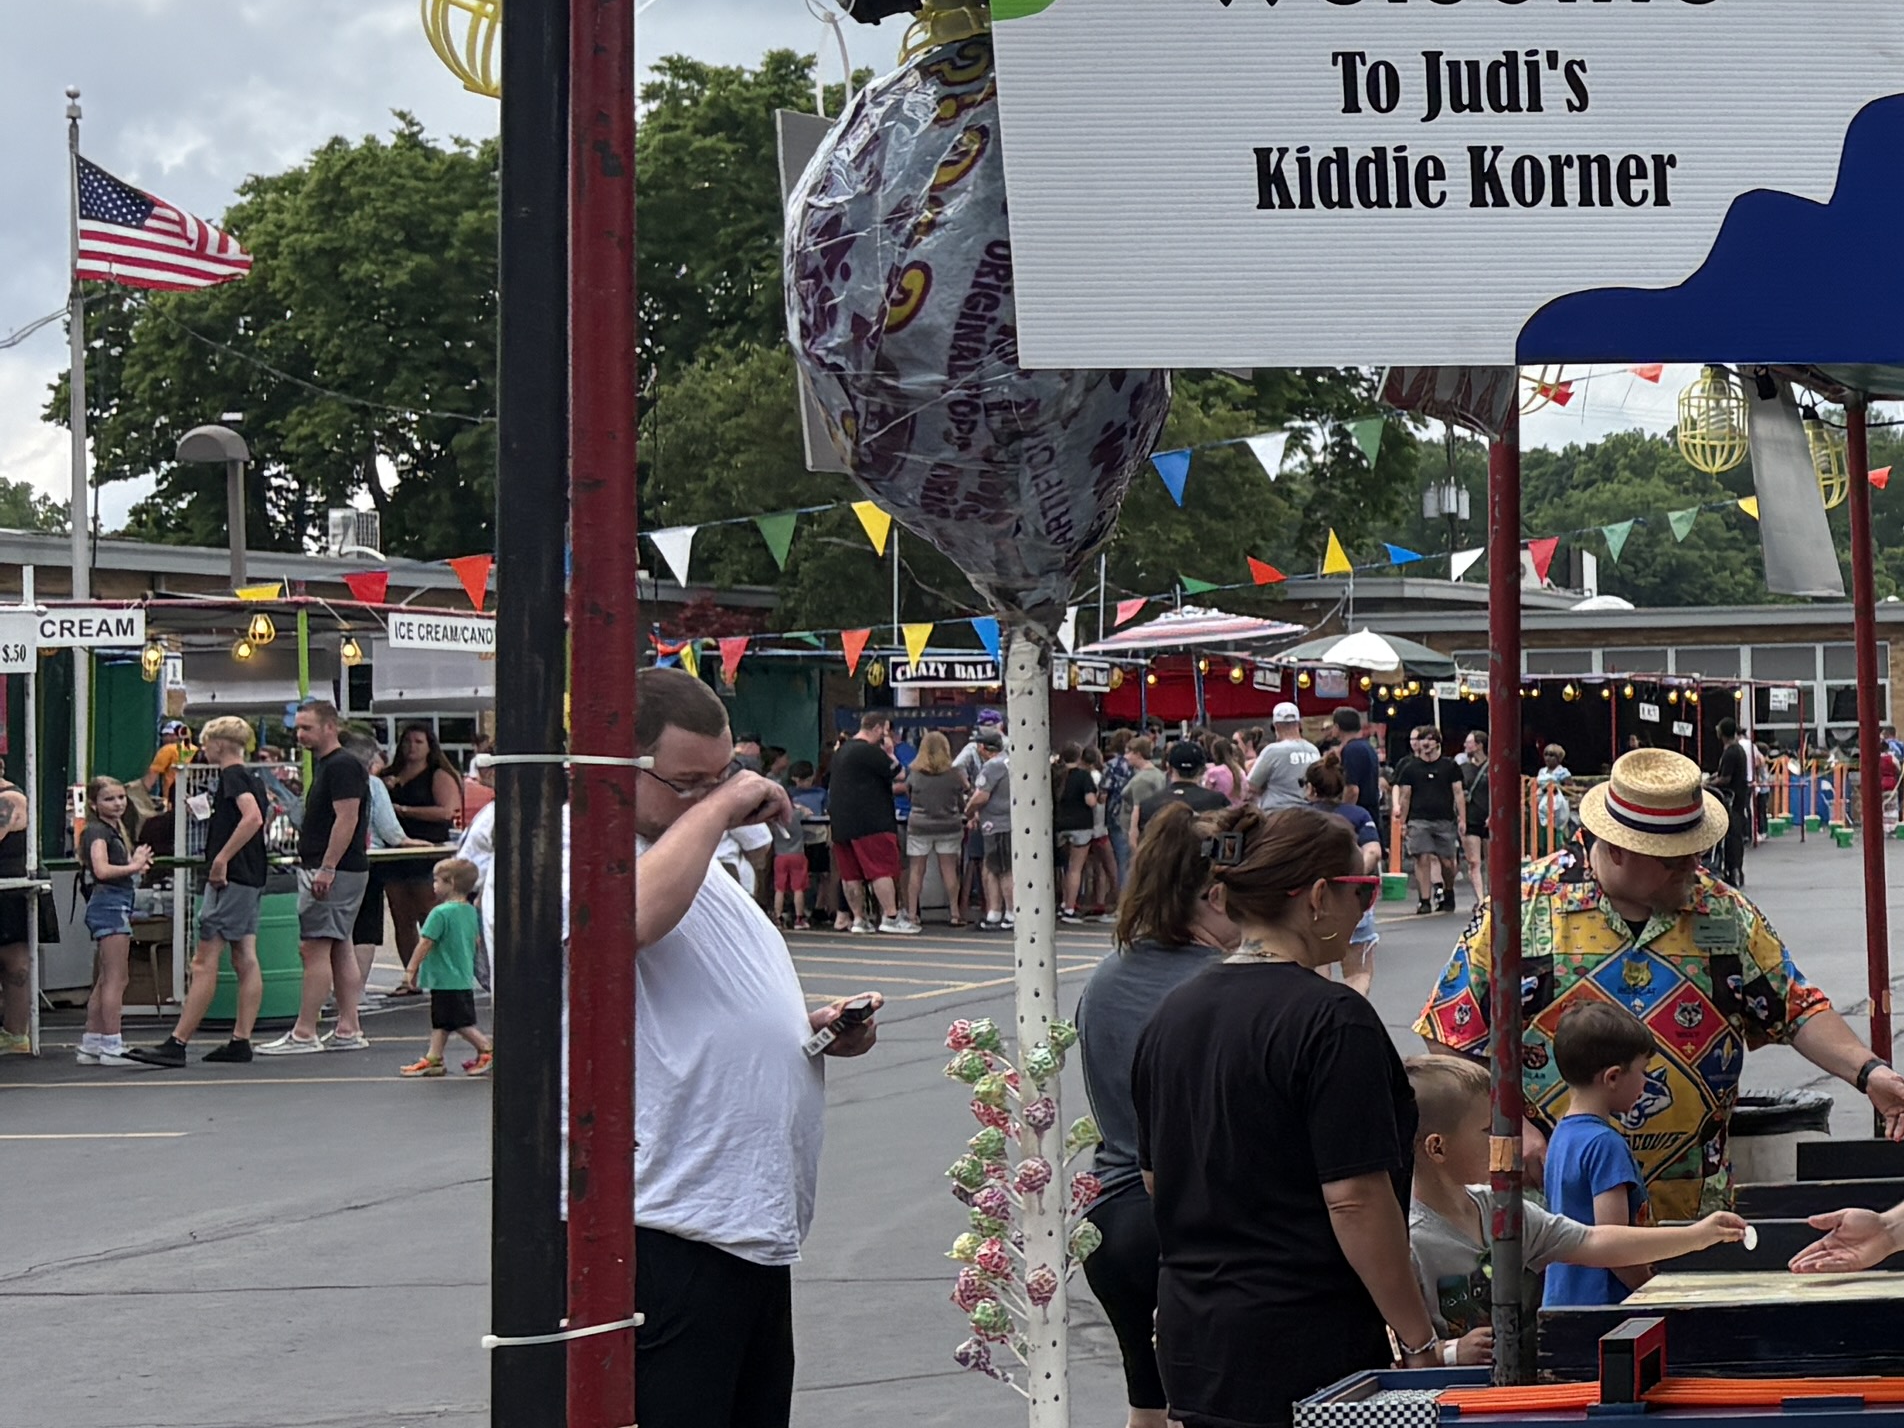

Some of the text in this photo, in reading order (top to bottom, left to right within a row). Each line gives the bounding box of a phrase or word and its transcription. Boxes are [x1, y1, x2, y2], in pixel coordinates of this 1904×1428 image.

[1331, 48, 1590, 123] To Judi's
[1253, 144, 1677, 211] Kiddie Korner
[40, 618, 135, 638] CREAM
[395, 621, 495, 645] ICE CREAM/CAND
[954, 663, 996, 680] BALL
[1290, 752, 1321, 765] STA
